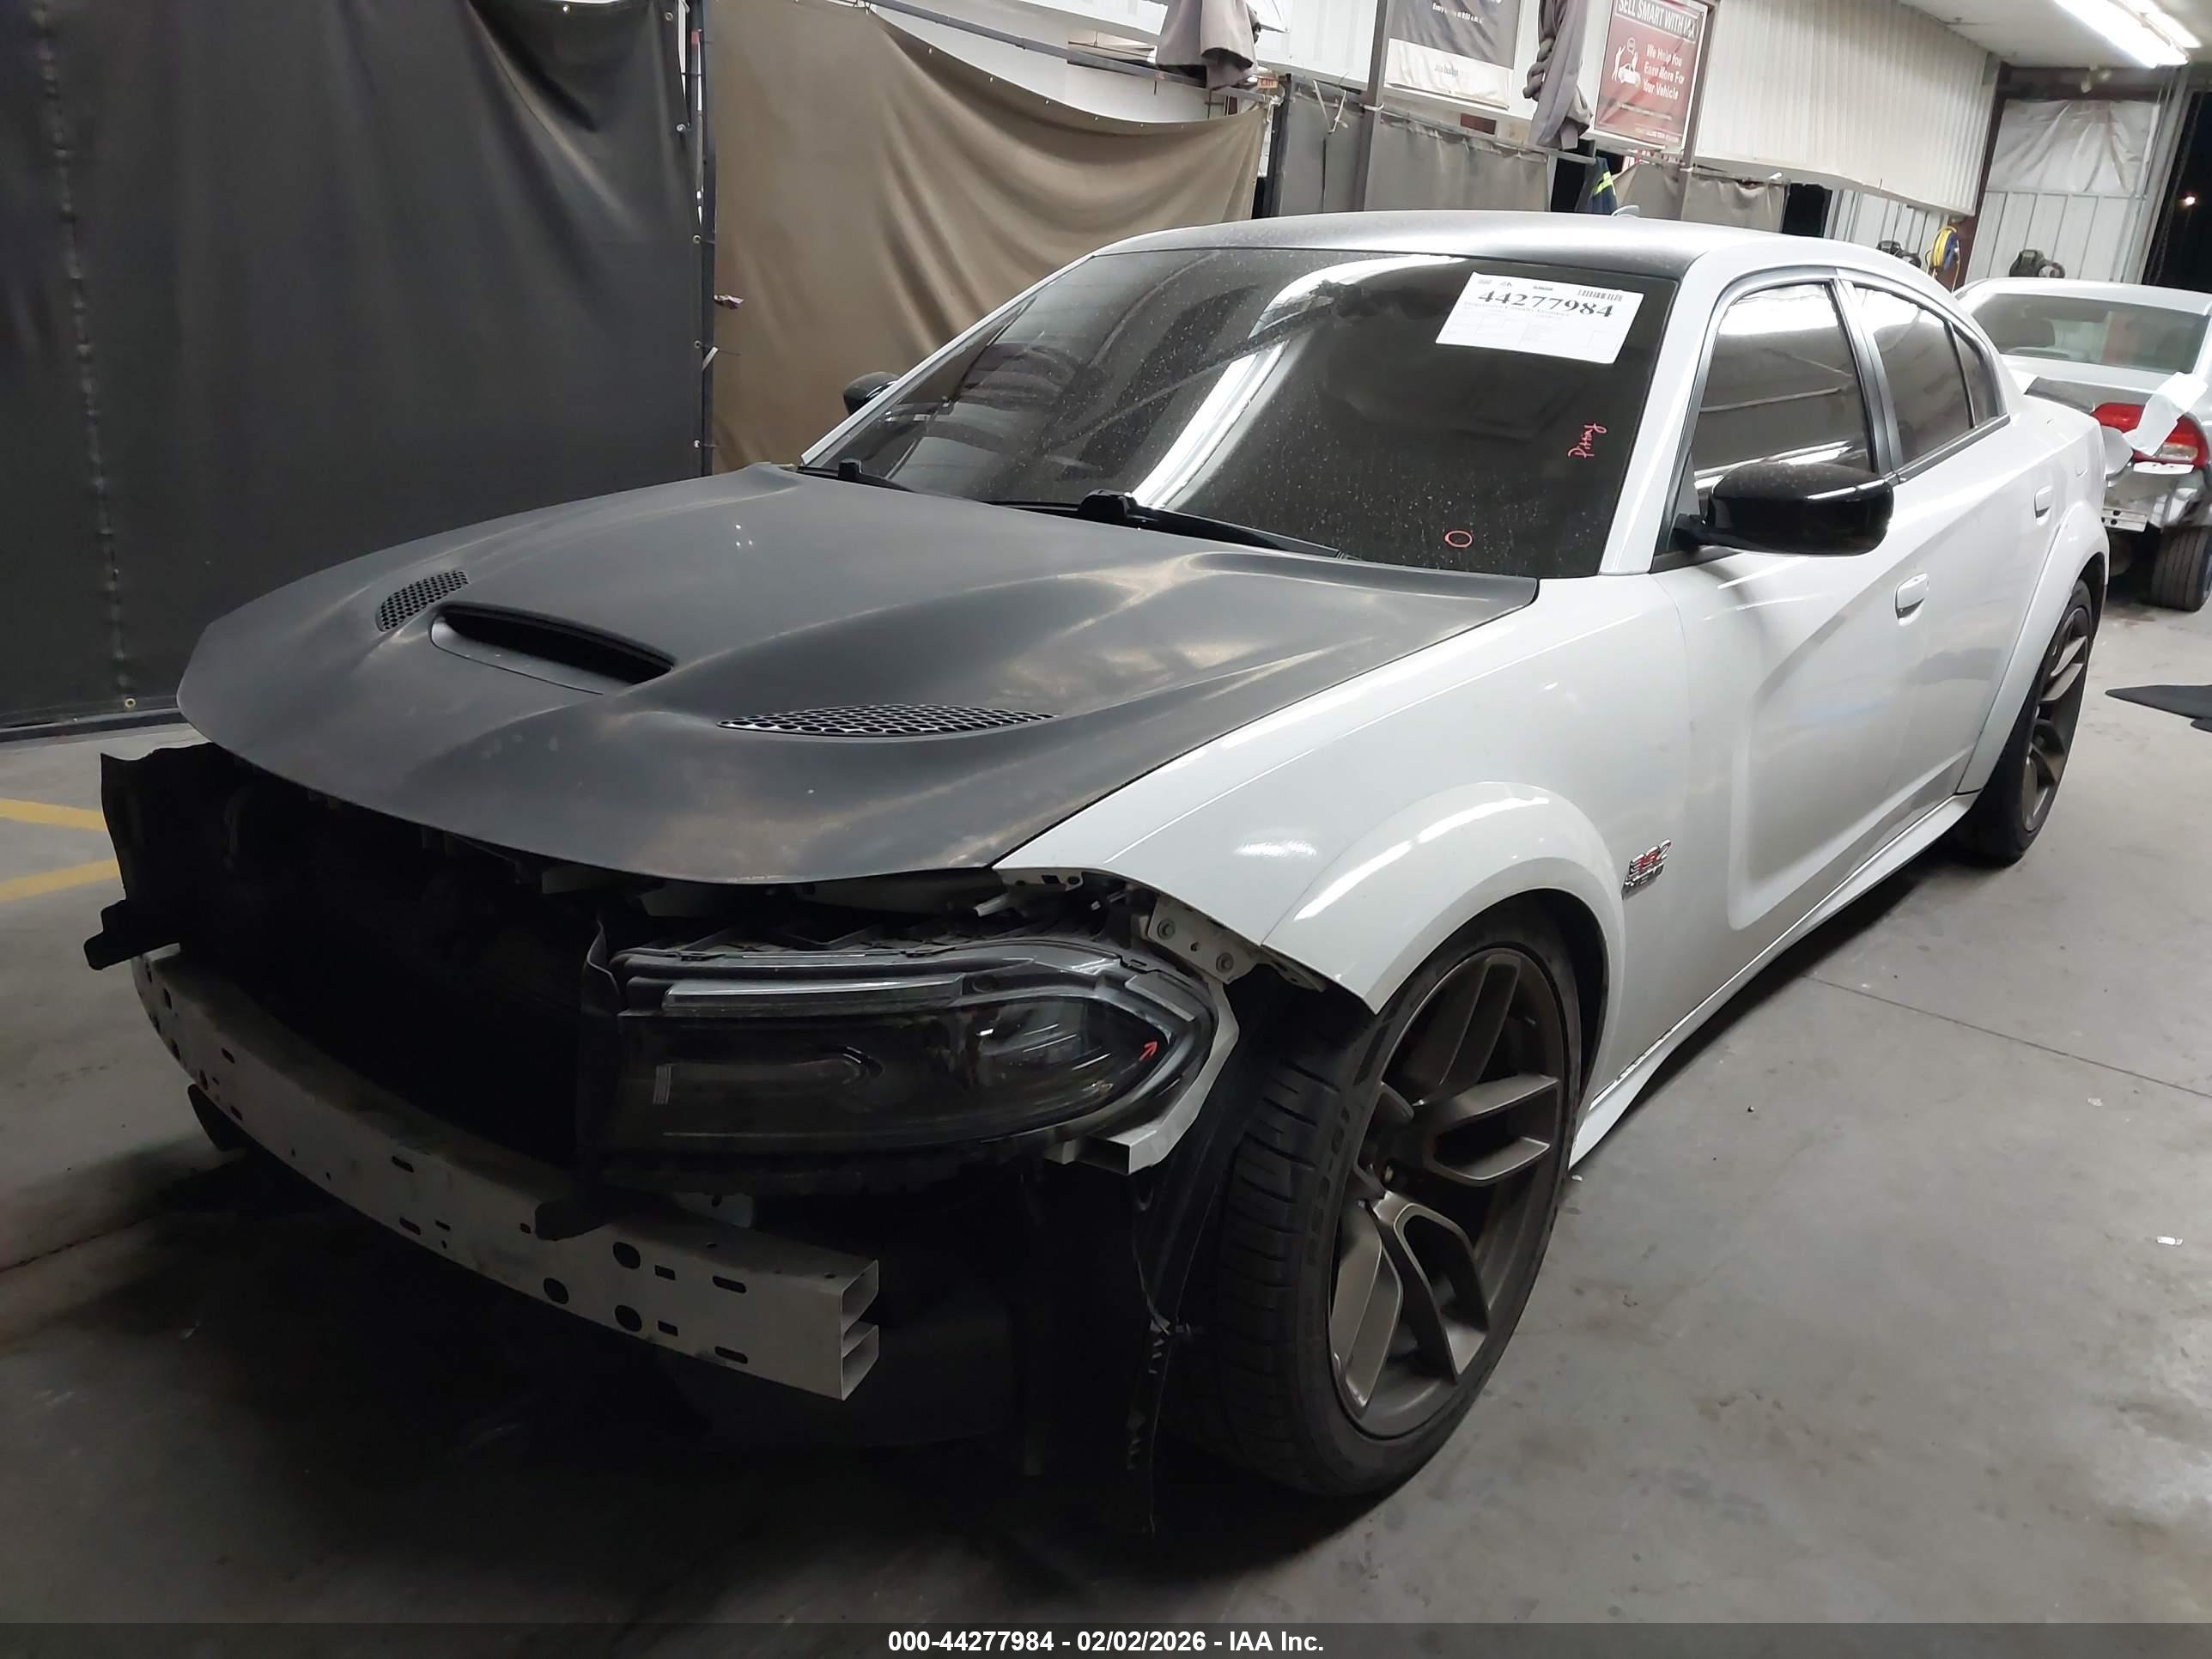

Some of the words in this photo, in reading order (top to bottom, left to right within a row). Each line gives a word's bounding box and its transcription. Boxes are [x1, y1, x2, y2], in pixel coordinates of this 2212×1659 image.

[1619, 0, 1636, 15] SELL
[1638, 1, 1664, 25] SMART
[1666, 9, 1684, 33] WITH
[1647, 44, 1656, 58] We
[1672, 52, 1683, 67] You
[1656, 82, 1679, 100] Vehicle
[1478, 290, 1614, 318] 44277984
